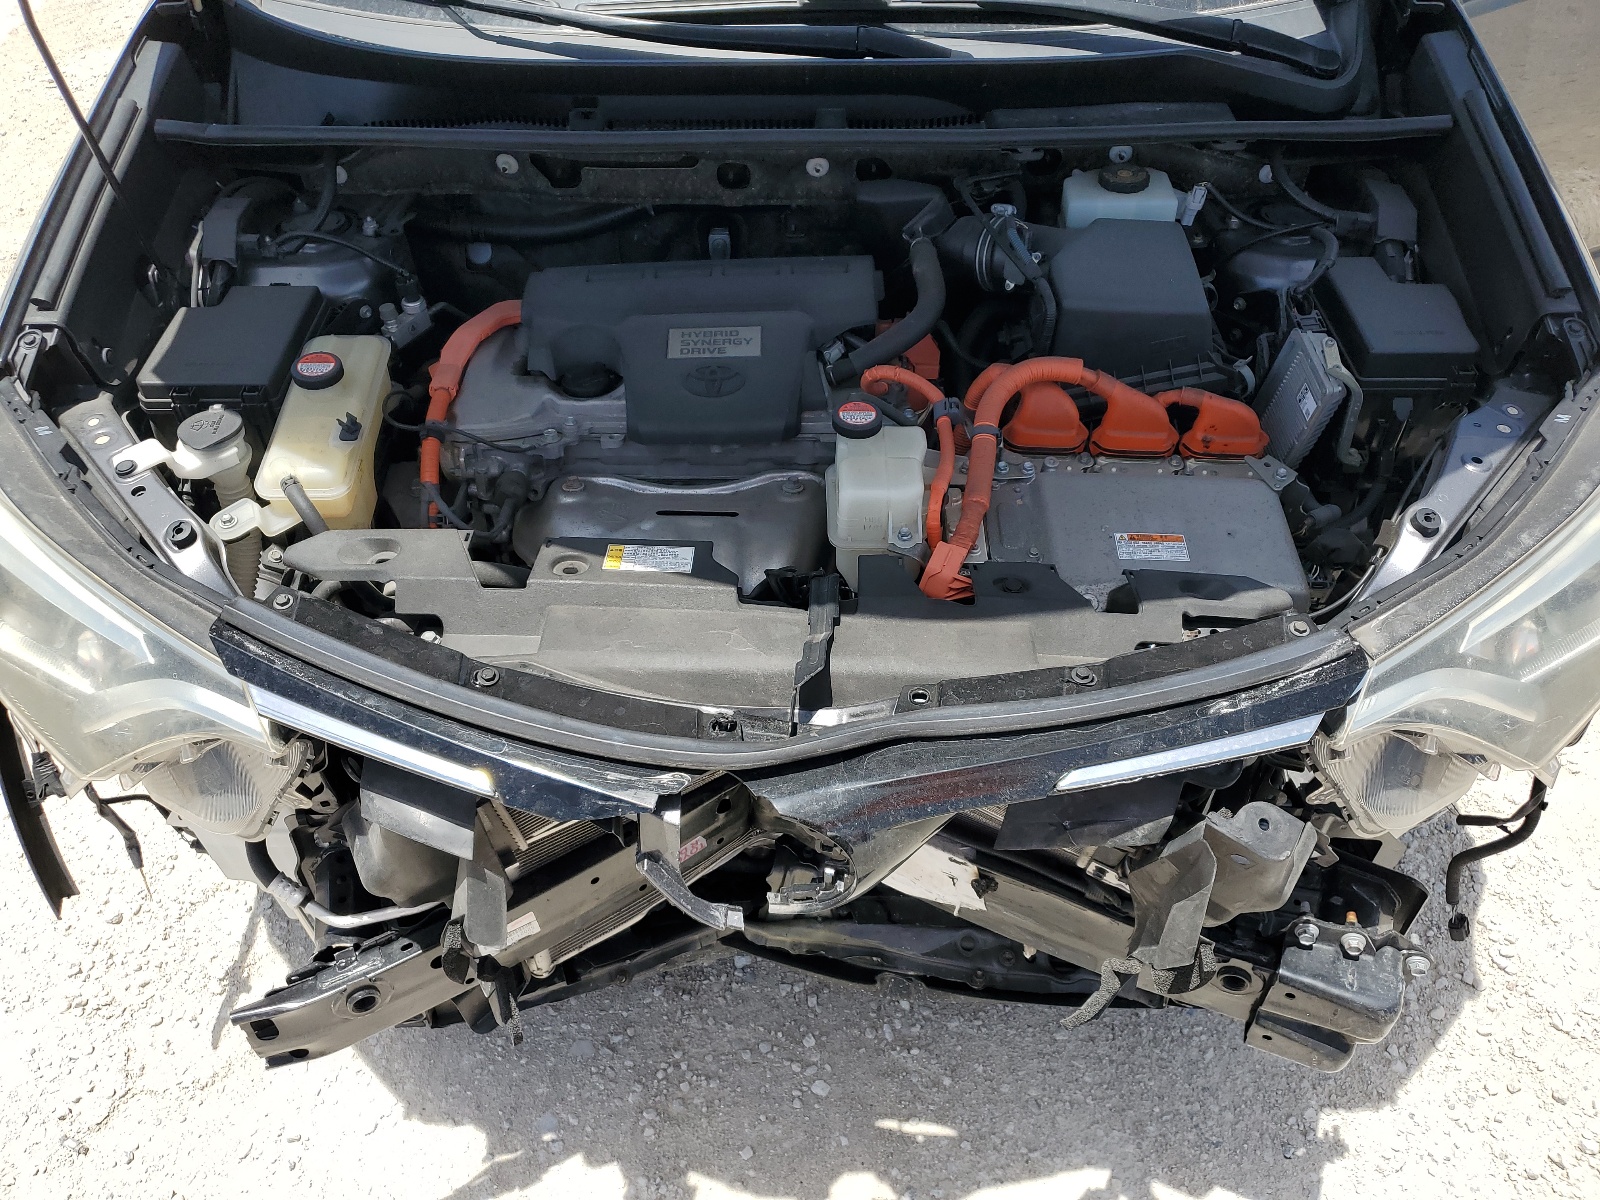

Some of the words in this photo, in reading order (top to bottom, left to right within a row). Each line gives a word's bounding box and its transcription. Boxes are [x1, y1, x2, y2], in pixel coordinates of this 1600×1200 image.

[681, 330, 740, 338] HYBRID
[680, 338, 752, 347] SYNERGY
[680, 347, 727, 355] DRIVE
